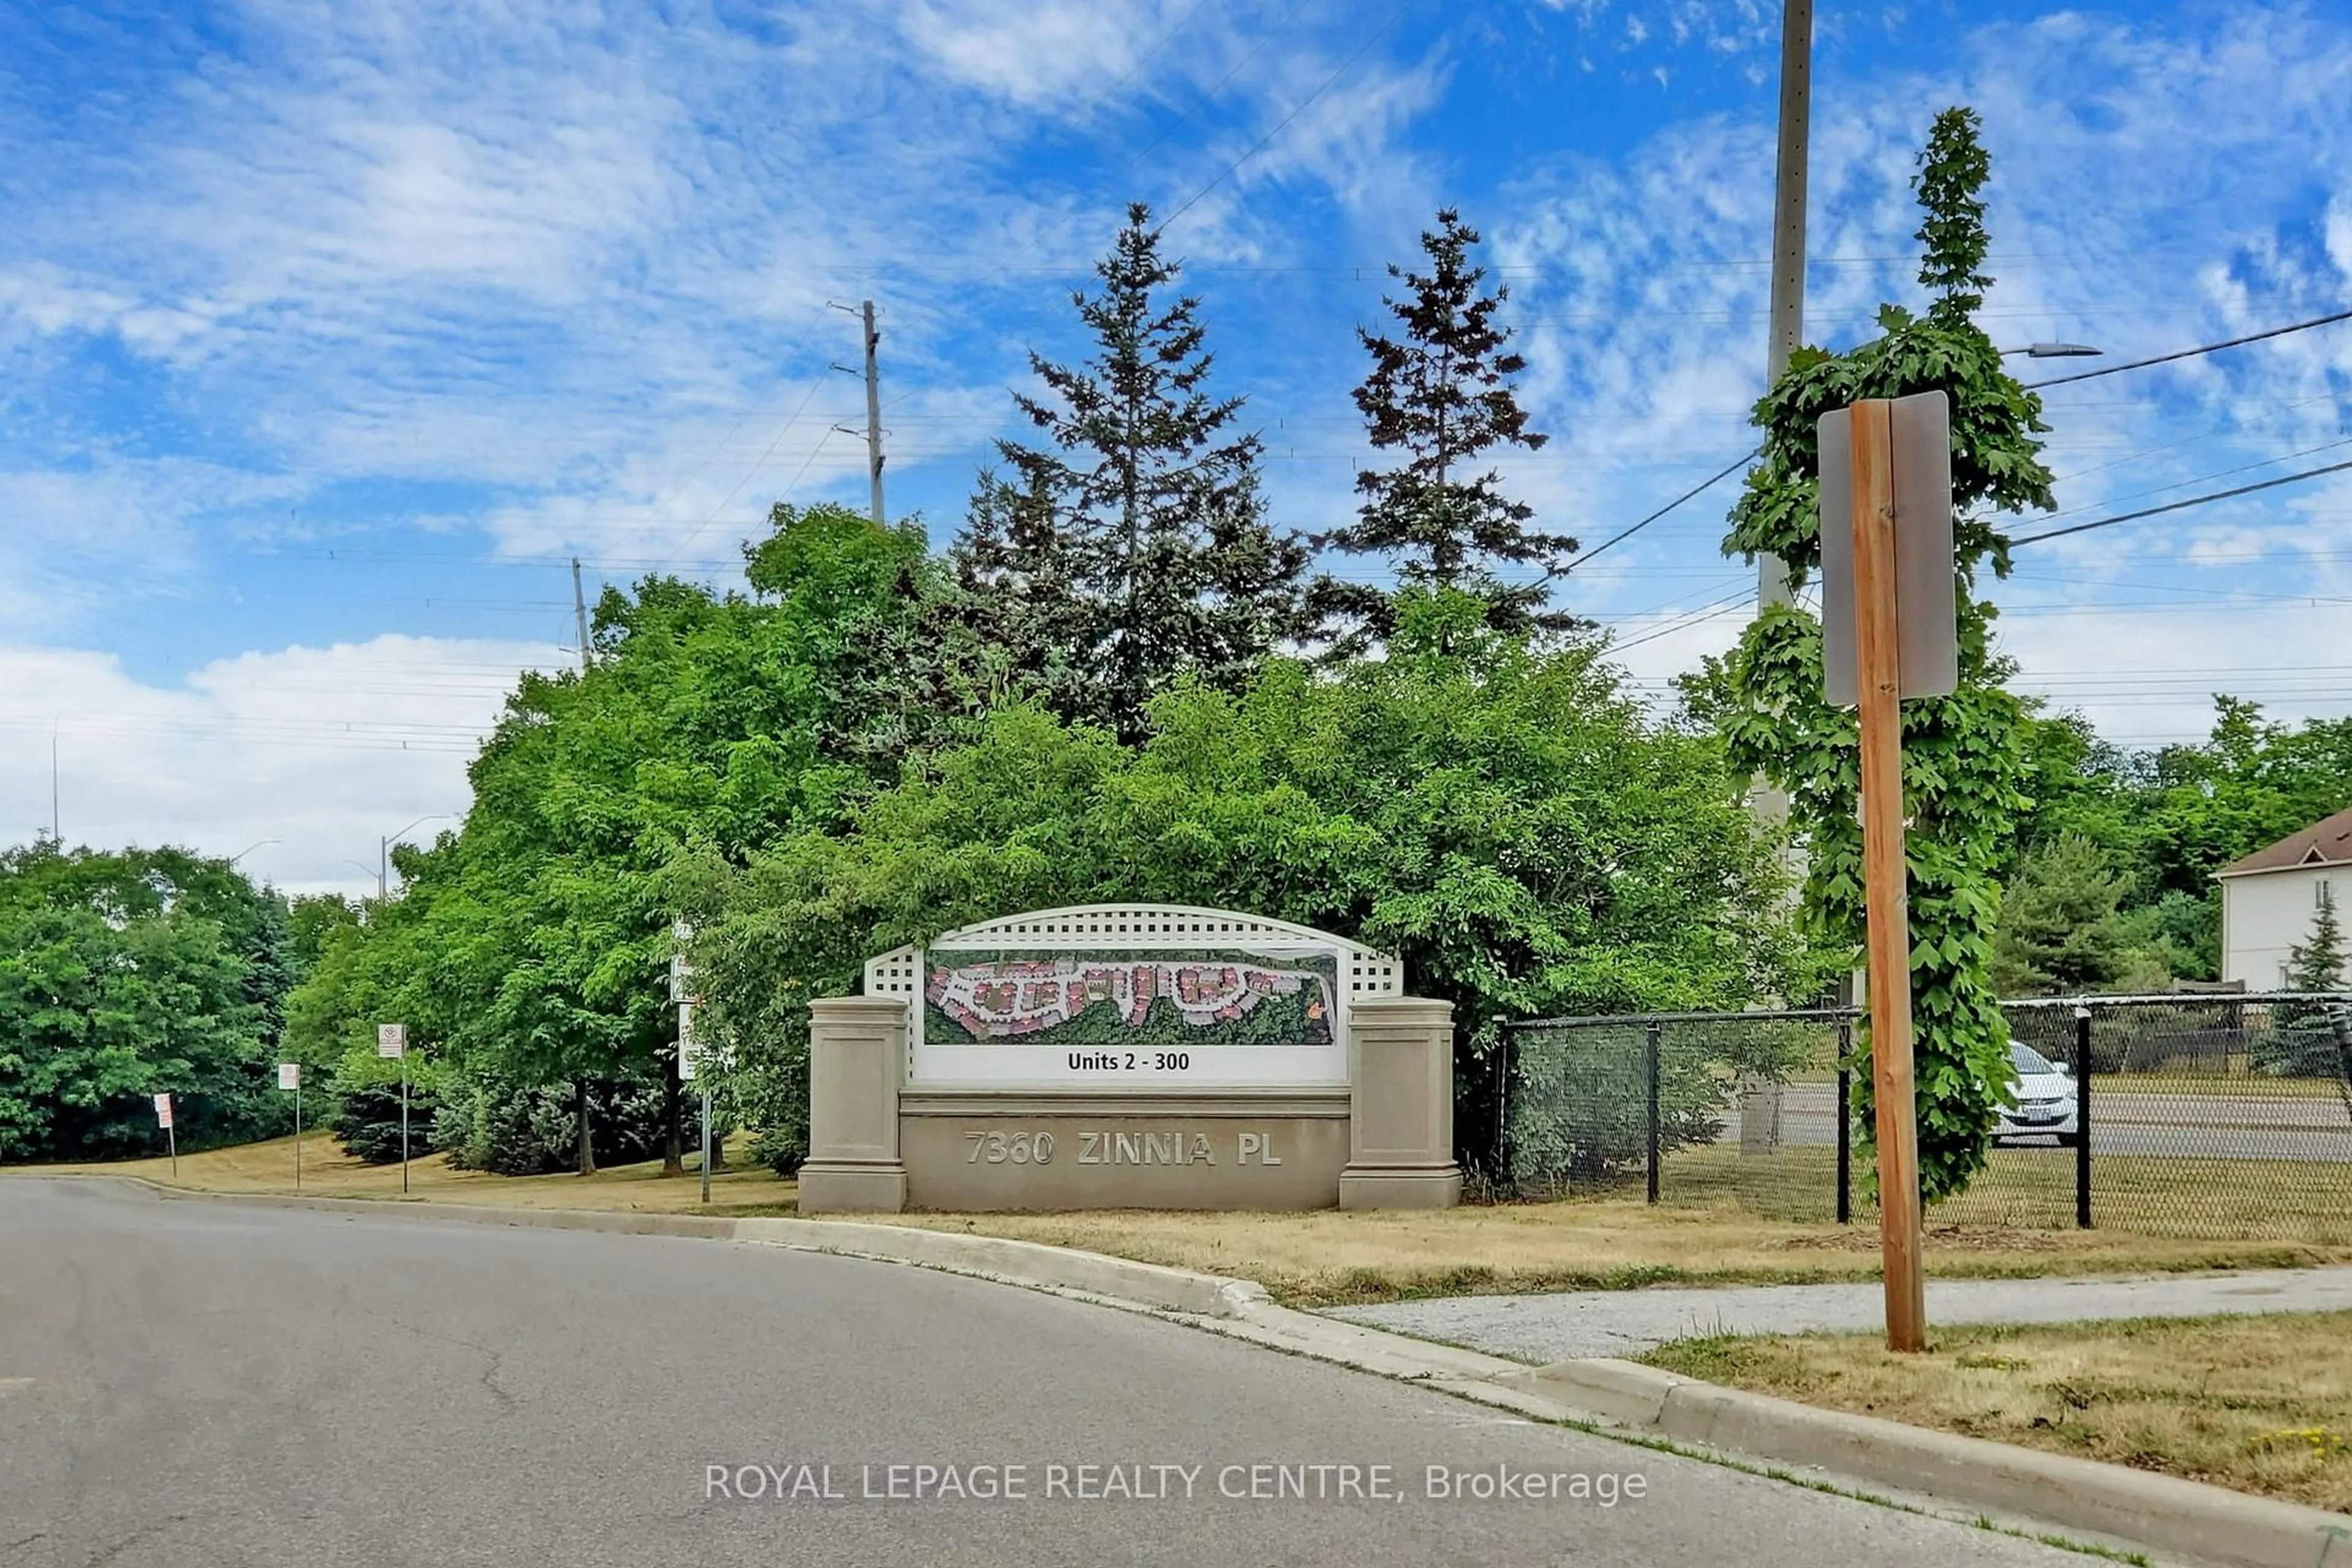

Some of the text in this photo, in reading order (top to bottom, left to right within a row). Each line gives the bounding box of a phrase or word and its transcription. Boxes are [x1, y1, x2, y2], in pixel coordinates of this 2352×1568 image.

[1068, 1052, 1118, 1070] Units
[1125, 1053, 1135, 1070] 2
[1155, 1053, 1189, 1070] 300
[964, 1131, 1283, 1165] 7360 ZINNIA PL
